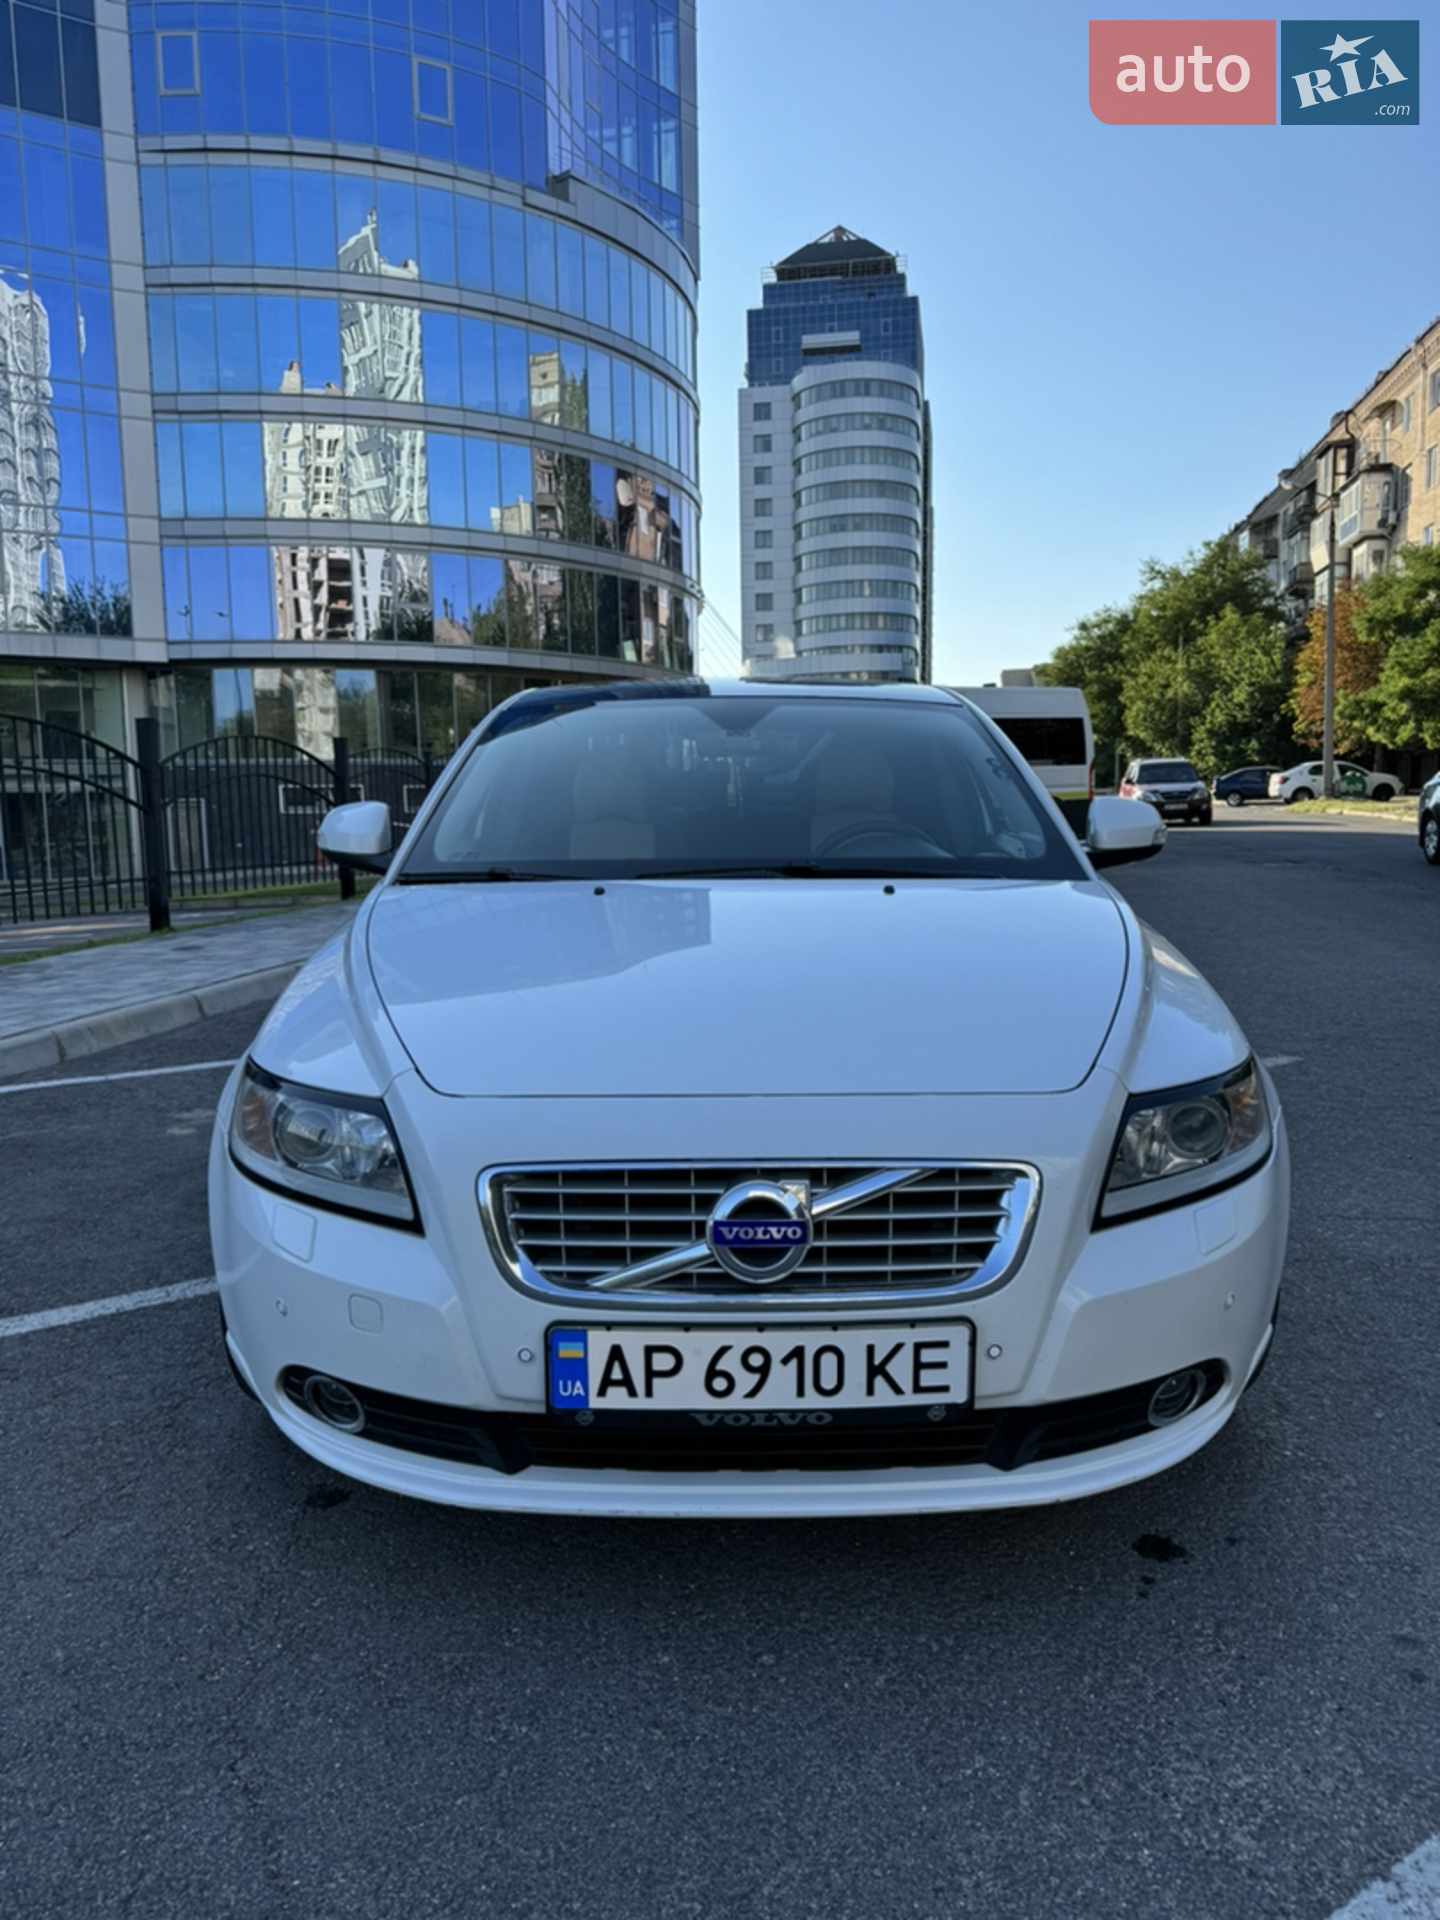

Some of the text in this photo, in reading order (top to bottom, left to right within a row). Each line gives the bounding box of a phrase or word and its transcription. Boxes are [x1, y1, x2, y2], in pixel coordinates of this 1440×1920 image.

[718, 1226, 802, 1240] VOLVO
[596, 1340, 951, 1399] AP 6910 KE
[558, 1380, 585, 1397] UA
[690, 1411, 833, 1426] VOLVO
